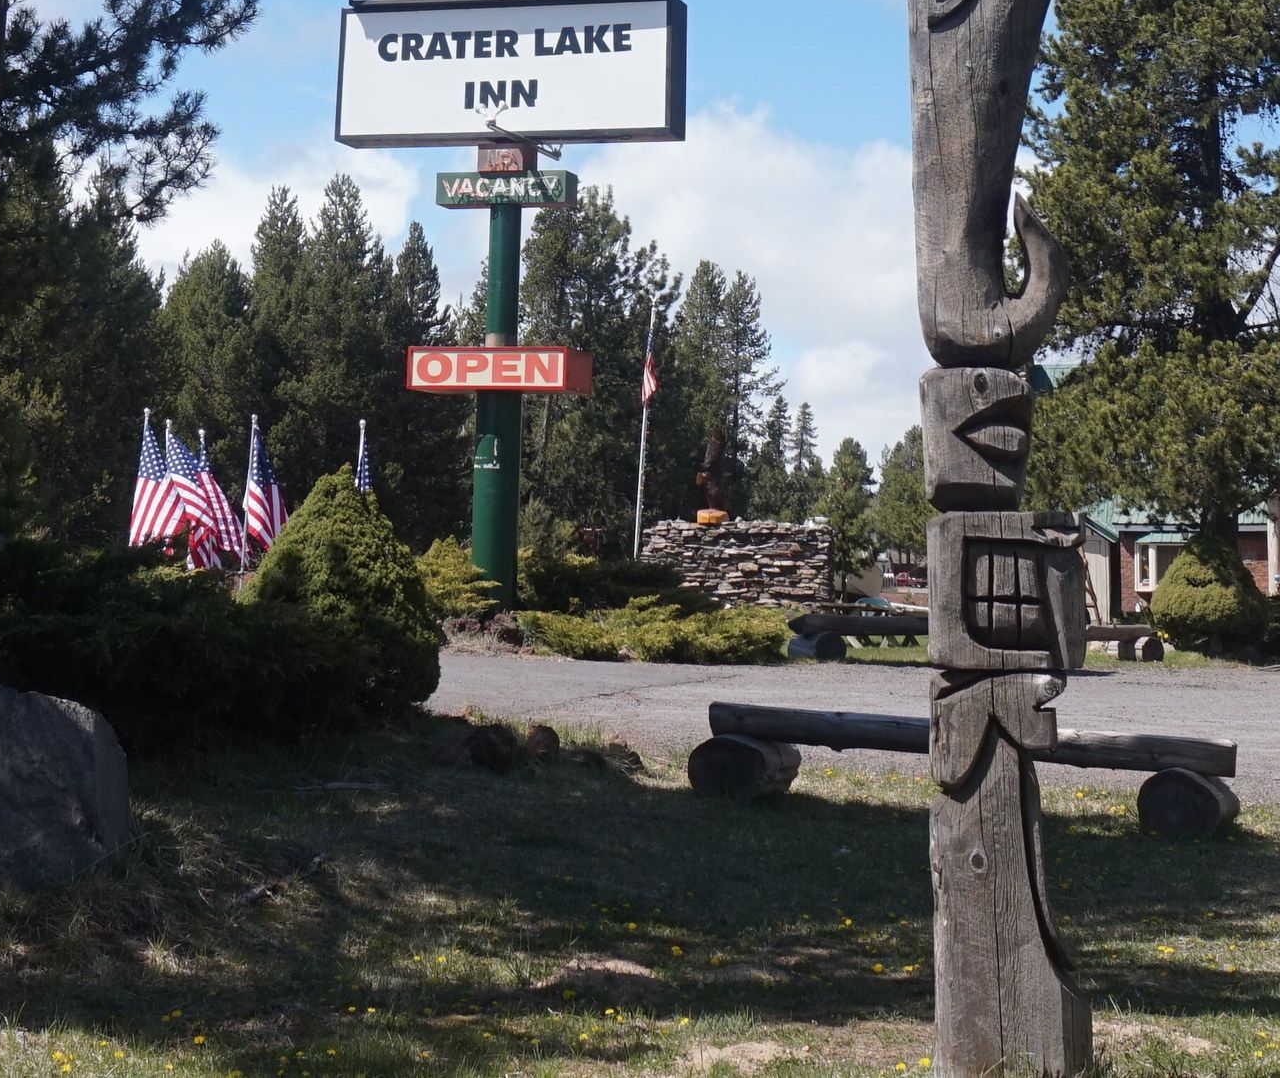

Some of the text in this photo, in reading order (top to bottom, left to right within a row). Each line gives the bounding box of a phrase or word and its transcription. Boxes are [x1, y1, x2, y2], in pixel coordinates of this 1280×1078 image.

[378, 23, 632, 62] CRATER LAKE
[464, 79, 538, 110] INN
[442, 176, 559, 198] VACANCY
[416, 353, 559, 384] OPEN
